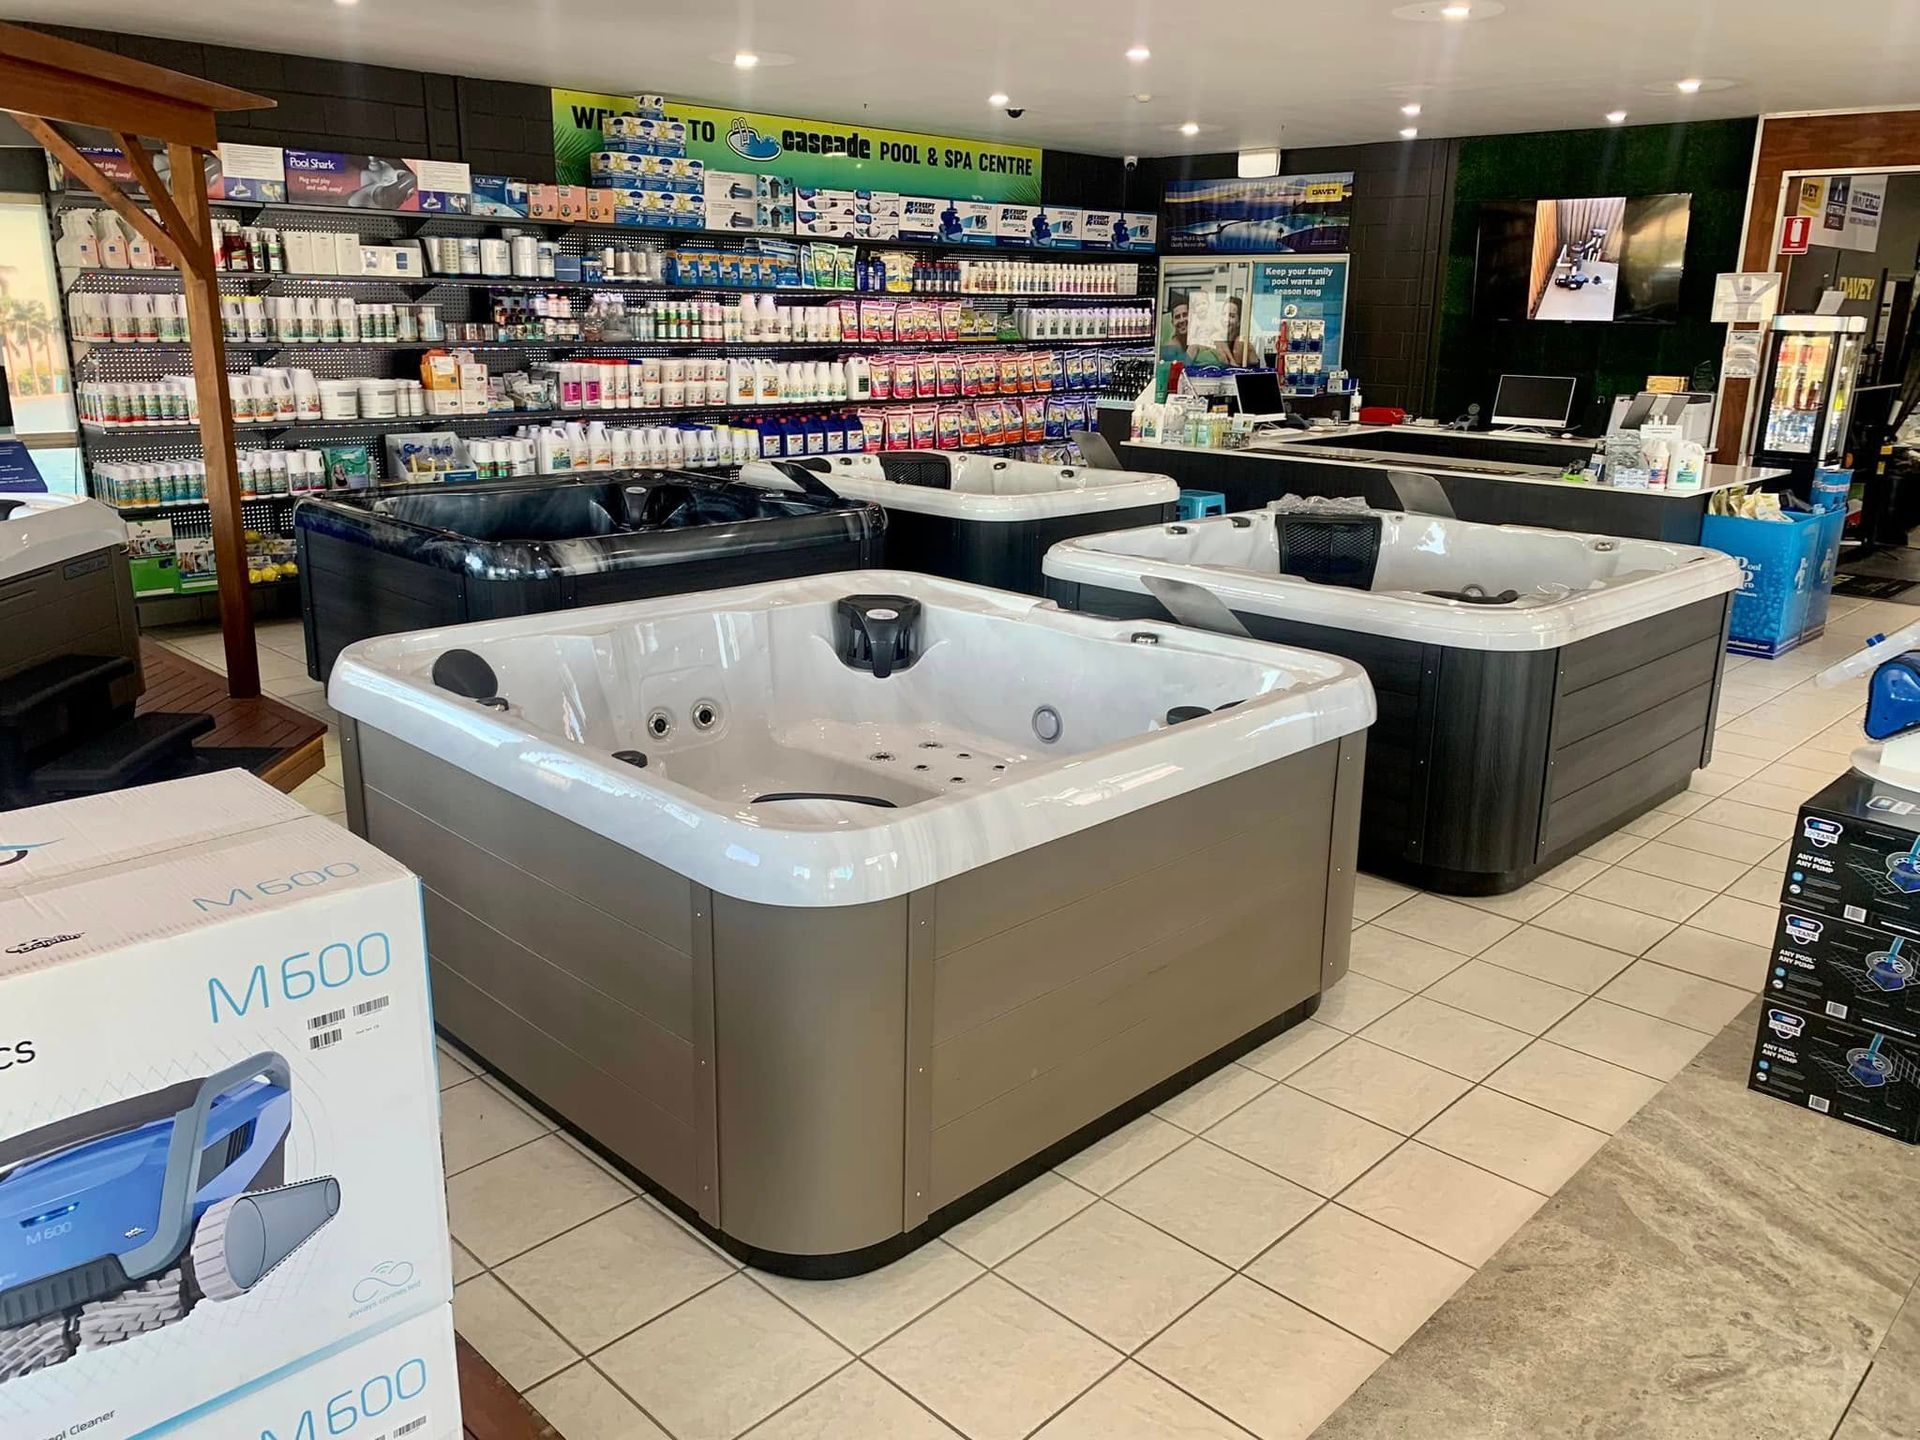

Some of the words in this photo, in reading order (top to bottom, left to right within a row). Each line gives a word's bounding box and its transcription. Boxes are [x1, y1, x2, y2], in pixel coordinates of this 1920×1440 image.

[688, 119, 715, 142] TO
[782, 130, 871, 160] cascade
[880, 142, 920, 165] POOL
[928, 147, 938, 166] &
[944, 150, 972, 170] SPA
[979, 152, 1032, 176] CENTRE
[290, 157, 309, 168] Pool
[310, 158, 335, 170] Shark
[1265, 268, 1287, 276] Keep
[1308, 267, 1333, 276] family
[1304, 288, 1321, 296] long
[1840, 276, 1876, 300] DAVEY
[1797, 852, 1813, 861] ANY
[1796, 859, 1812, 868] ANY
[1812, 863, 1834, 873] PUMP
[1779, 949, 1795, 957] ANY
[1778, 955, 1793, 964] ANY
[1794, 960, 1815, 970] PUMP
[1763, 1042, 1778, 1051] ANY
[1762, 1049, 1777, 1057] ANY
[1777, 1054, 1798, 1063] PUMP
[69, 1409, 116, 1435] Cleaner
